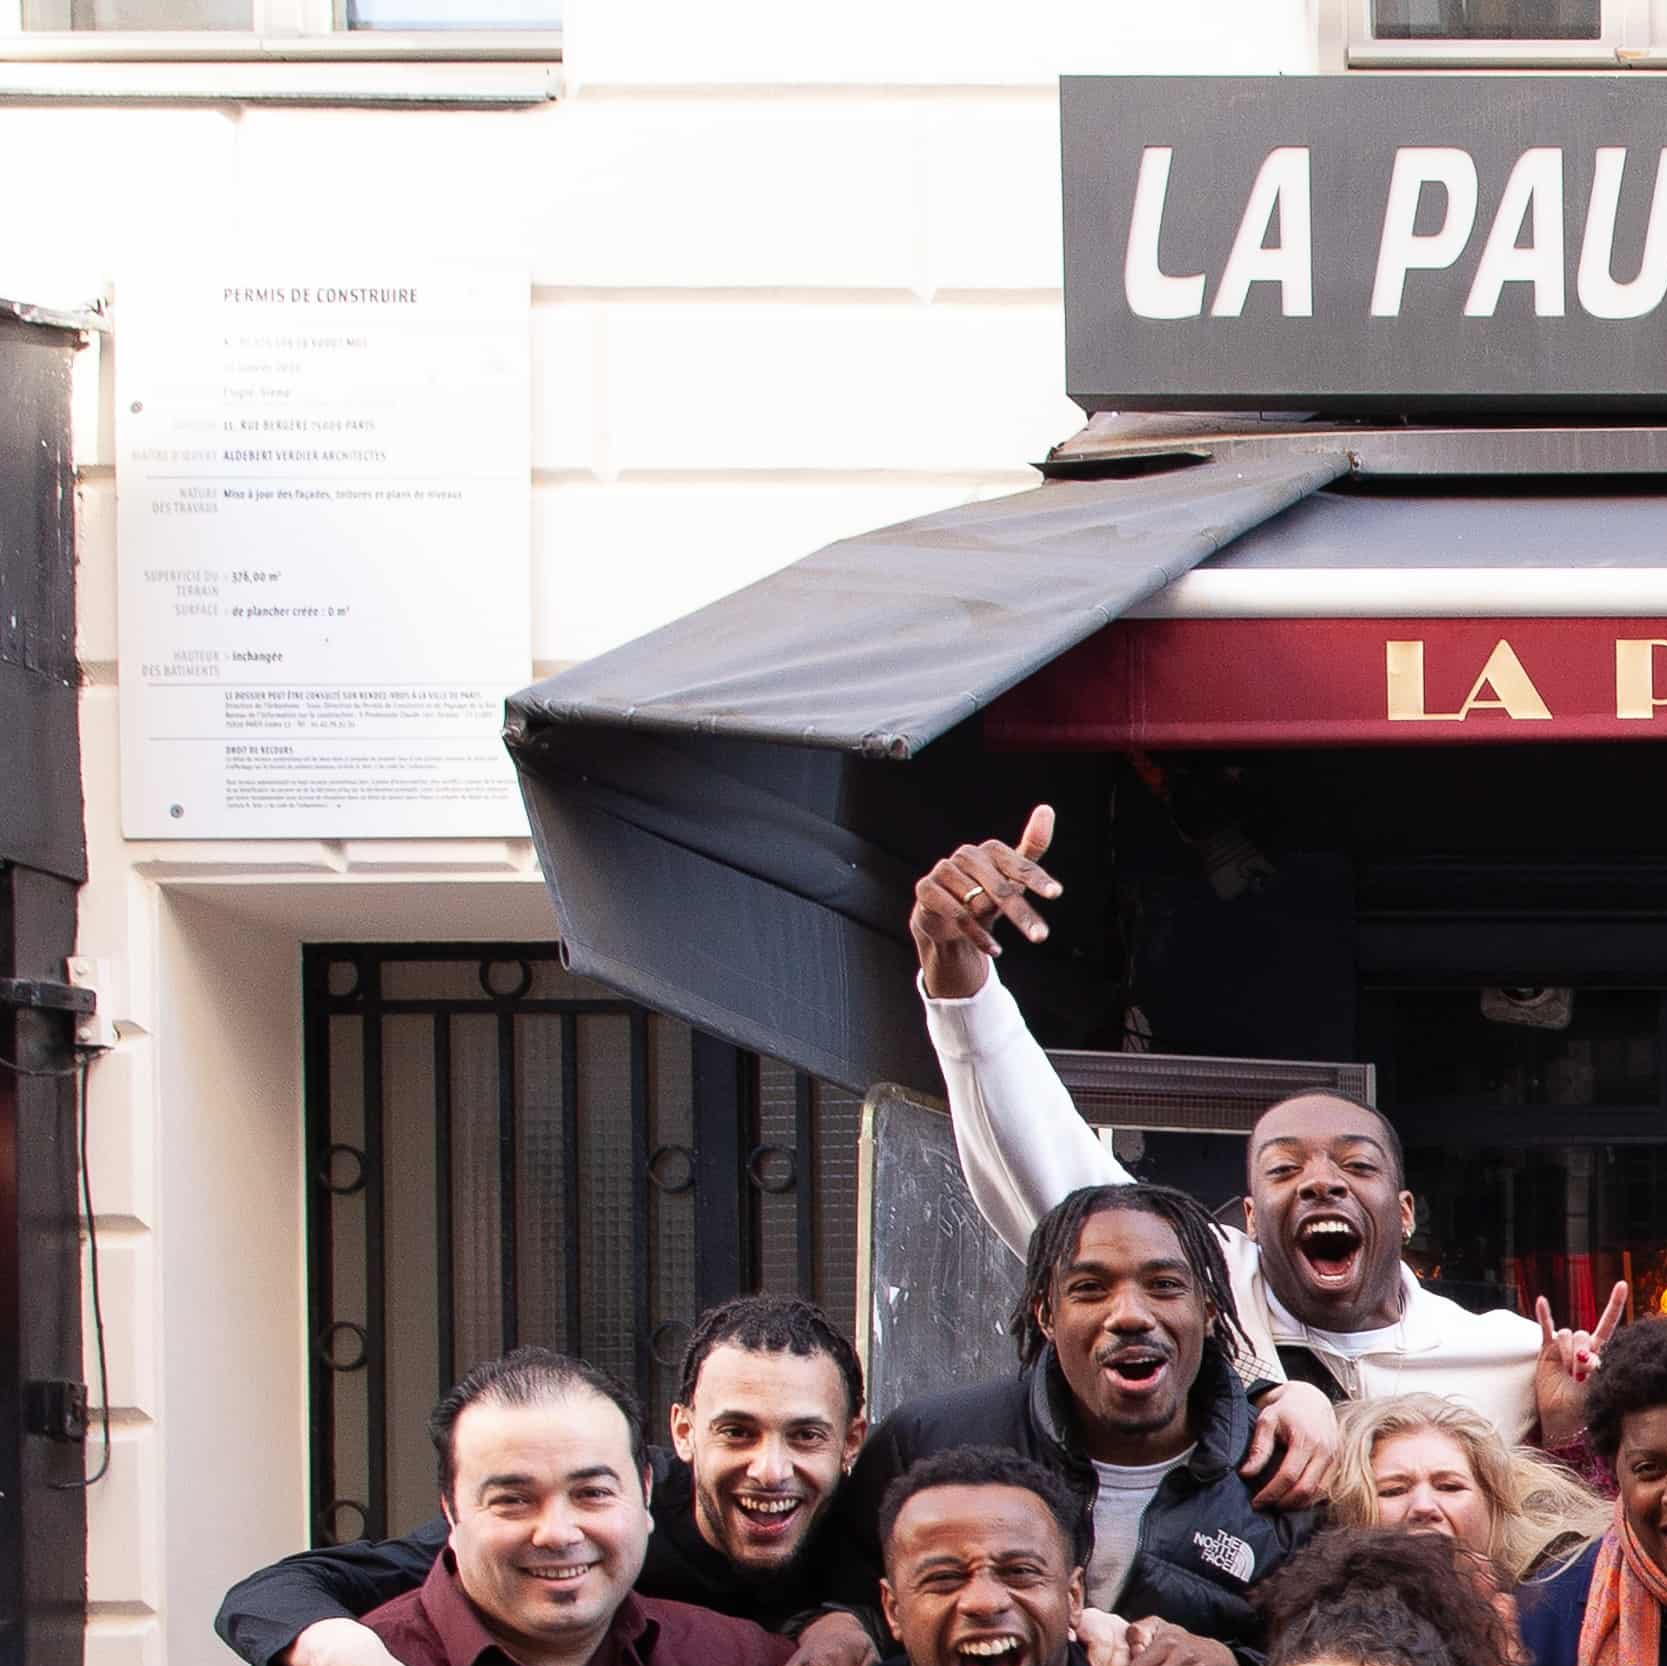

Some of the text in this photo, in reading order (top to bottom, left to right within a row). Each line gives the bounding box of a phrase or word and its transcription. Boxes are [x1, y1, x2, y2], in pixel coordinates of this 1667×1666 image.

[1125, 147, 1313, 320] LA
[223, 288, 418, 304] PERMIS DE CONSTRUIRE
[239, 420, 263, 432] RUE
[345, 420, 376, 432] PARIS
[223, 450, 387, 462] ALDEBERT VERDIER ARCHITECTES
[223, 489, 245, 500] Mise
[255, 489, 275, 502] jour
[277, 489, 292, 500] des
[175, 605, 218, 616] SURFACE
[232, 606, 244, 617] de
[247, 606, 290, 619] plancher
[173, 651, 219, 662] HAUTEUR
[232, 651, 283, 664] inchangée
[1386, 639, 1553, 722] LA
[1193, 1531, 1238, 1560] NORTH
[1217, 1528, 1242, 1551] THE
[1201, 1548, 1233, 1571] FACE
